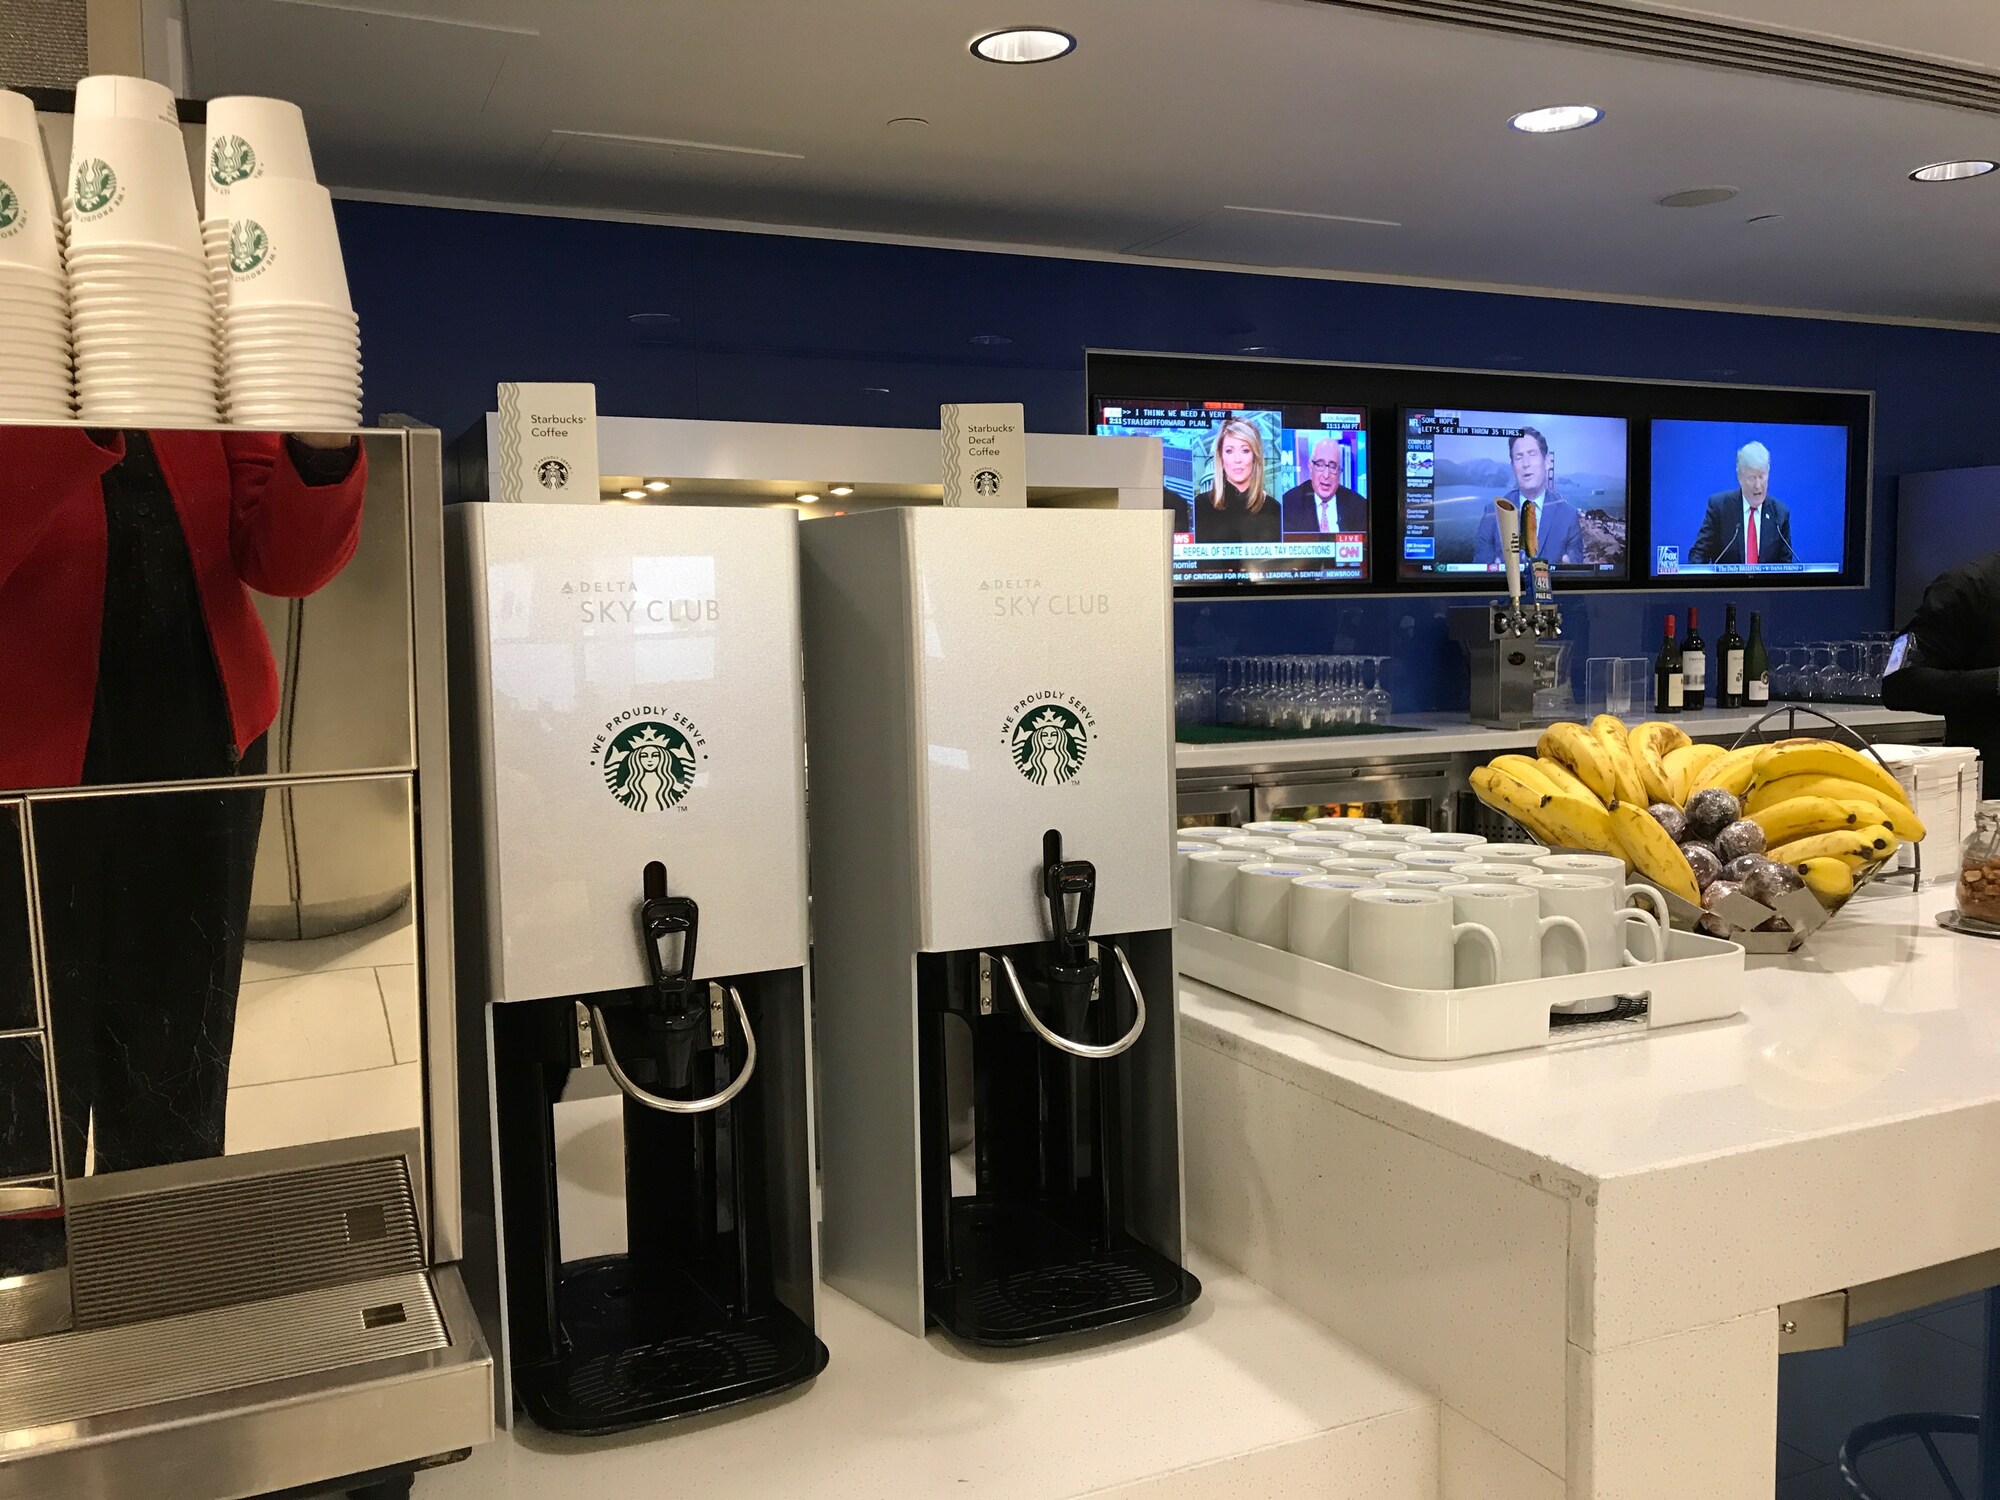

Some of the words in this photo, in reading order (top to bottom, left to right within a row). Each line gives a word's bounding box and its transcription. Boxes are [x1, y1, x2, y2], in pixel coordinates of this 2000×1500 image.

[1143, 409, 1165, 417] THINK
[1180, 410, 1198, 418] NEED
[1209, 410, 1226, 418] VERY
[531, 414, 584, 424] Starbucks
[1122, 418, 1186, 427] STRAIGHTFORWARD
[1189, 419, 1210, 427] PLAN.
[1421, 417, 1437, 425] SOME
[531, 427, 568, 437] Coffee
[968, 424, 1013, 433] Starbucks
[1491, 428, 1499, 436] 35
[1502, 428, 1522, 436] TIMES.
[968, 436, 995, 444] Decaf
[968, 447, 1000, 456] Coffee
[1183, 546, 1209, 556] REPEAL
[1211, 547, 1220, 556] OF
[1222, 546, 1243, 556] STATE
[1251, 546, 1272, 556] LOCAL
[1274, 546, 1286, 555] TAX
[1289, 545, 1330, 555] DEDUCTIONS
[1338, 546, 1359, 558] CNN
[1173, 561, 1197, 569] nomist
[1660, 560, 1678, 568] NEWS
[580, 582, 638, 593] DELTA
[995, 579, 1042, 590] DELTA
[995, 596, 1040, 616] SKY
[1049, 594, 1109, 615] CLUB
[581, 600, 636, 623] SKY
[647, 600, 720, 623] CLUB
[1001, 716, 1014, 734] WE
[1013, 690, 1065, 713] PROUDLY
[1068, 696, 1096, 728] SERVE
[591, 734, 606, 755] WE
[605, 706, 668, 732] PROUDLY
[672, 712, 706, 747] SERVE
